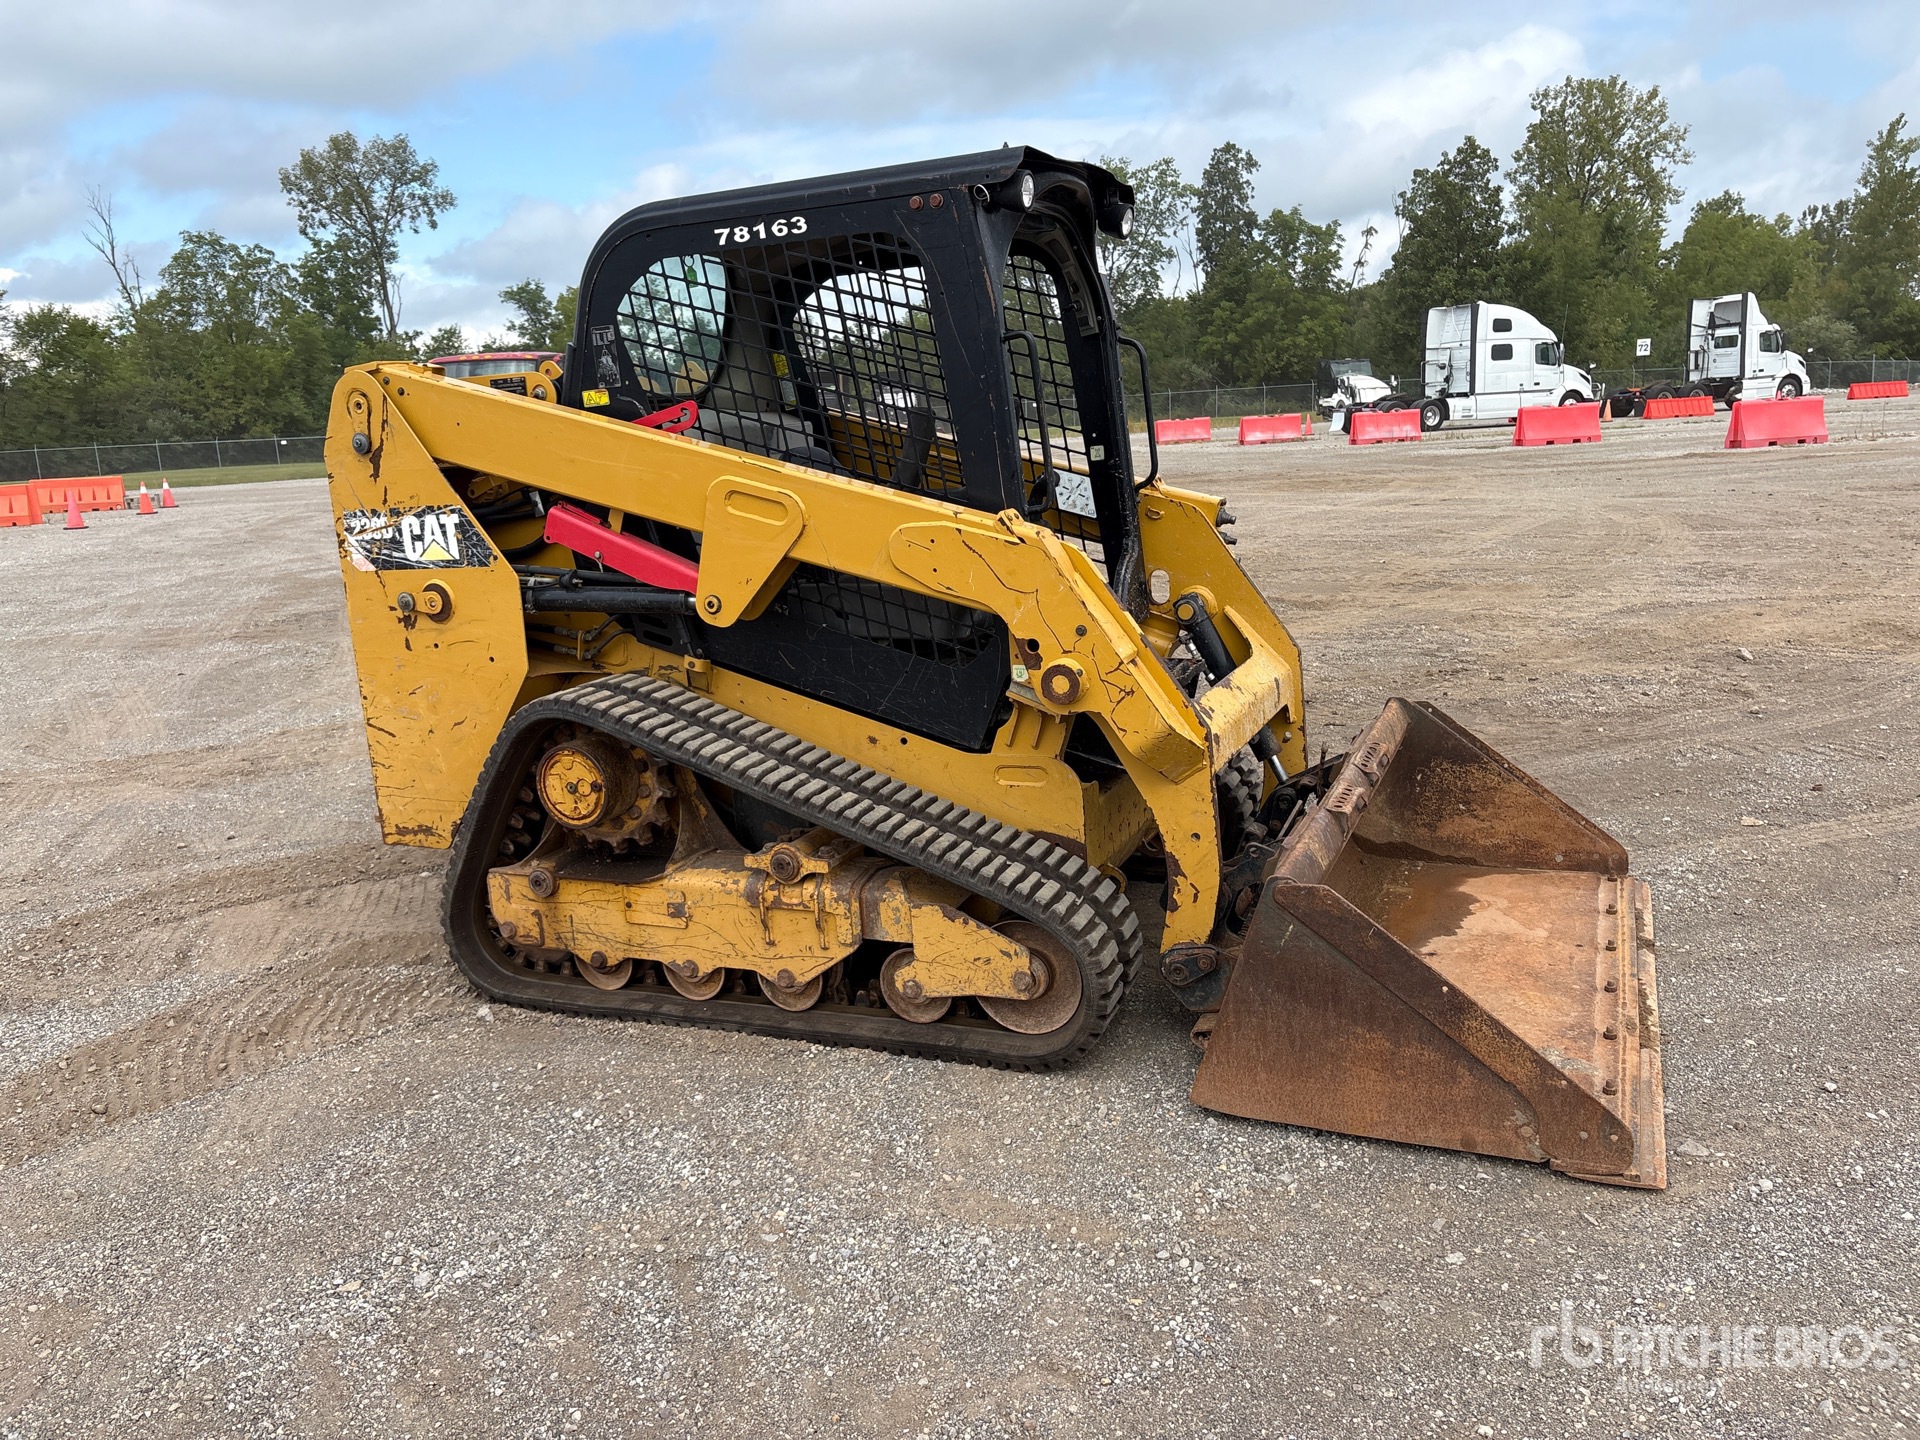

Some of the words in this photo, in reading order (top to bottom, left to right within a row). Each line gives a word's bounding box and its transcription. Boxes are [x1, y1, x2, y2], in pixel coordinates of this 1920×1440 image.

[713, 216, 808, 246] 78163
[1638, 343, 1649, 352] 72
[401, 513, 460, 562] CAT
